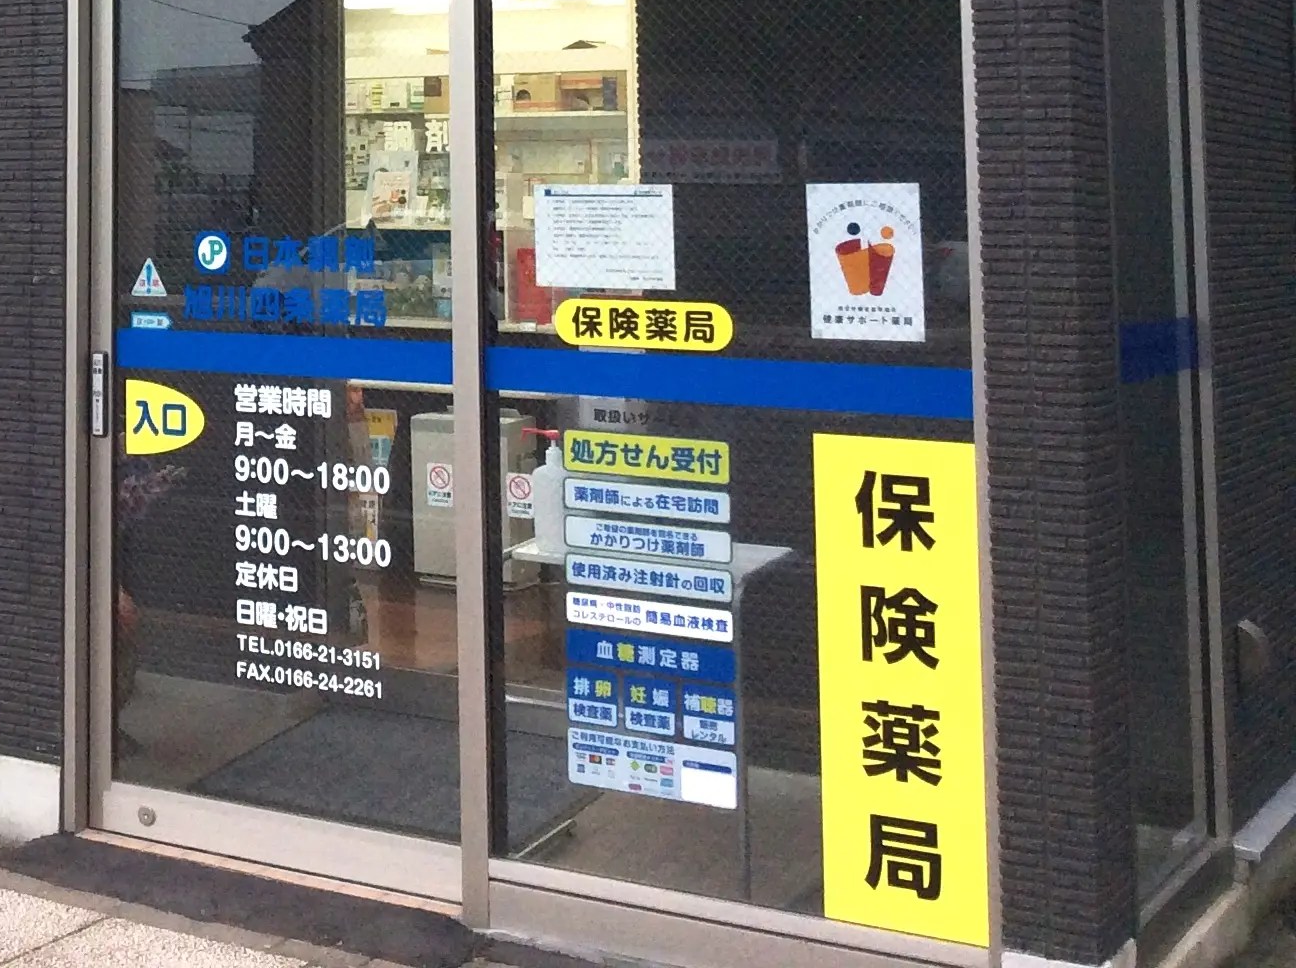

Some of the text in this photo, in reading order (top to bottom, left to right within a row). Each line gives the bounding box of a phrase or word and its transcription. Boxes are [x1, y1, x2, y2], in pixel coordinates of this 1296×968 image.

[243, 235, 375, 273] 日本調剤
[184, 285, 387, 326] 旭川四条薬局
[572, 306, 715, 343] 保険薬局
[234, 384, 332, 418] 営業時間
[133, 400, 187, 437] 入口
[570, 437, 722, 476] 処方せん受付
[235, 491, 278, 520] 土曜
[574, 486, 719, 515] 薬剤師による在宅訪問
[590, 533, 704, 557] かかりつけ薬剤師
[235, 561, 298, 592] 定休日
[572, 561, 725, 594] 使用済み注射針の回収
[236, 599, 328, 635] 日曜・祝日
[573, 609, 642, 626] コレステロールの
[646, 610, 729, 633] 簡易血液検査
[236, 634, 381, 670] TEL.0166-21-3151
[596, 640, 700, 671] 血糖測定器
[236, 661, 383, 698] FAX.0166-24-2261
[855, 469, 943, 901] 保険薬局
[573, 703, 612, 721] 検査薬
[630, 685, 670, 707] 妊娠
[630, 711, 670, 730] 検査薬
[692, 729, 727, 744] レンタル
